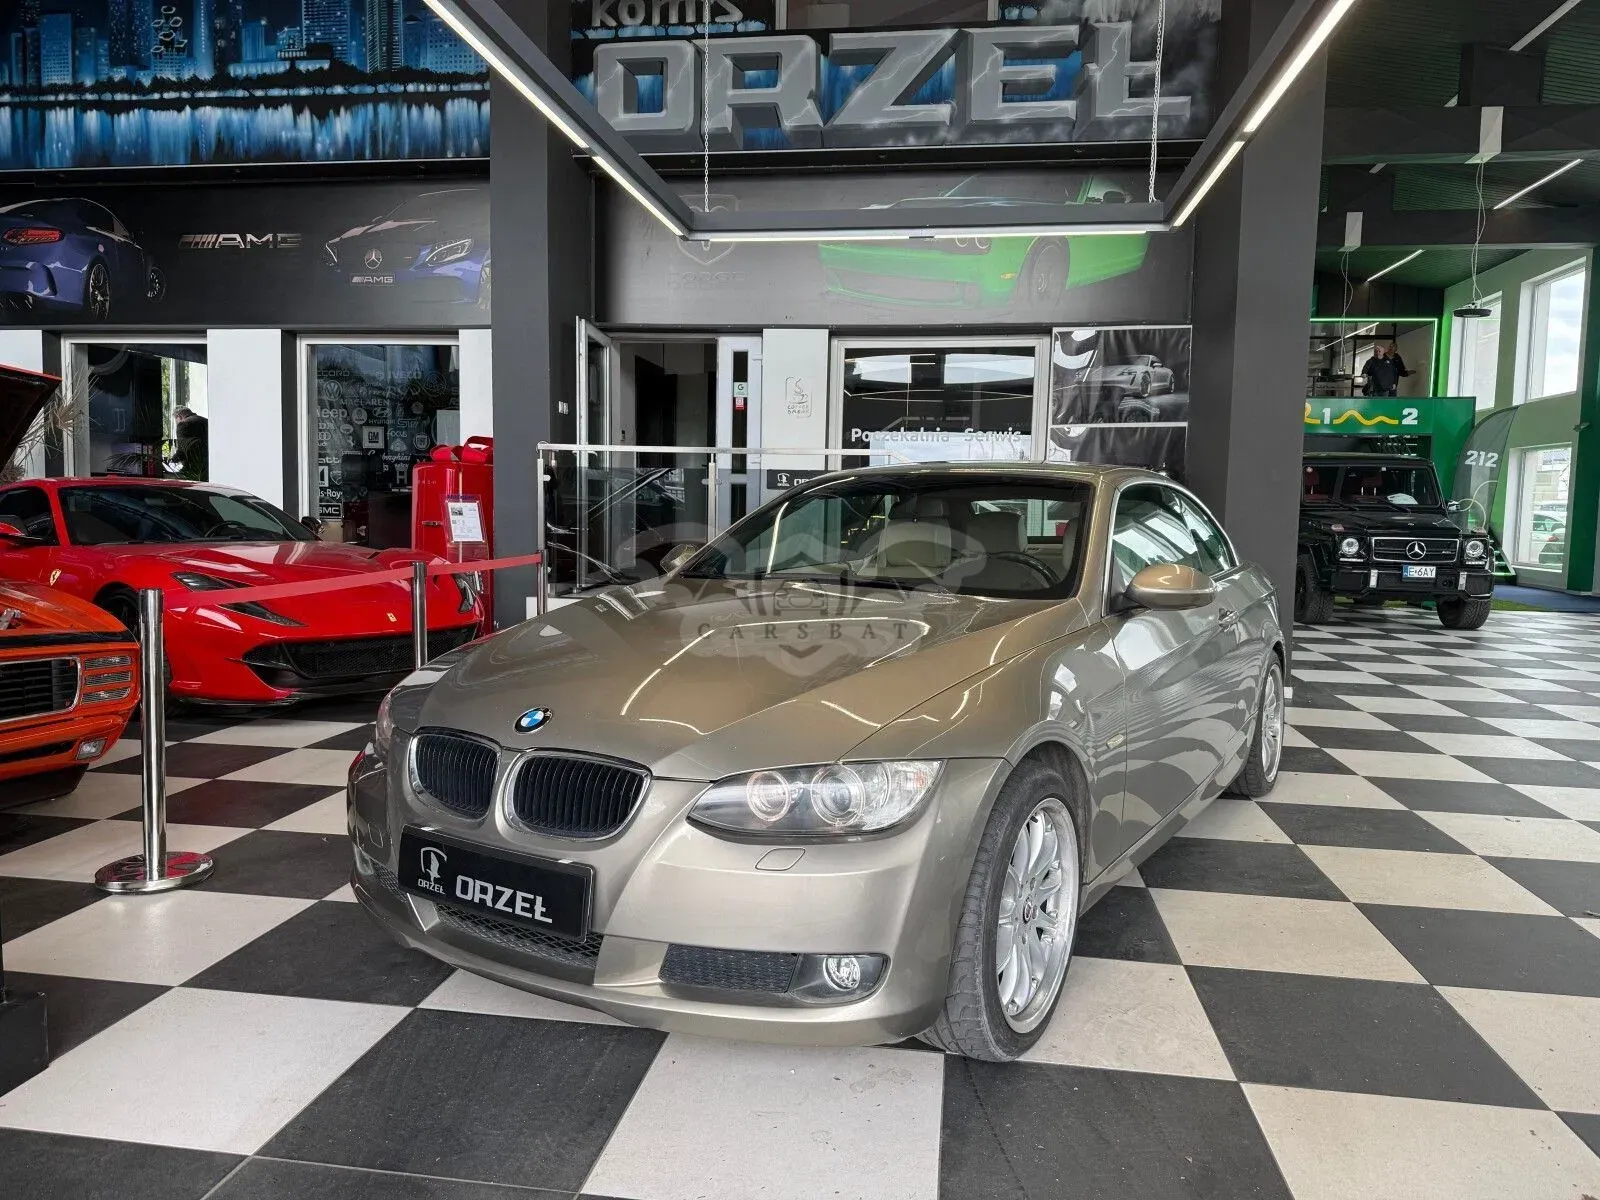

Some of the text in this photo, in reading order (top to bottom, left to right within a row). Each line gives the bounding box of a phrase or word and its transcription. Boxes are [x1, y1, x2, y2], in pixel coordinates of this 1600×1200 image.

[593, 20, 1192, 144] ORZEŁ
[1401, 407, 1419, 425] 2
[851, 427, 1021, 442] Poczekalnia Serwis
[1464, 450, 1499, 467] 212
[417, 878, 446, 895] ORZEŁ
[455, 874, 552, 924] ORZEŁ
